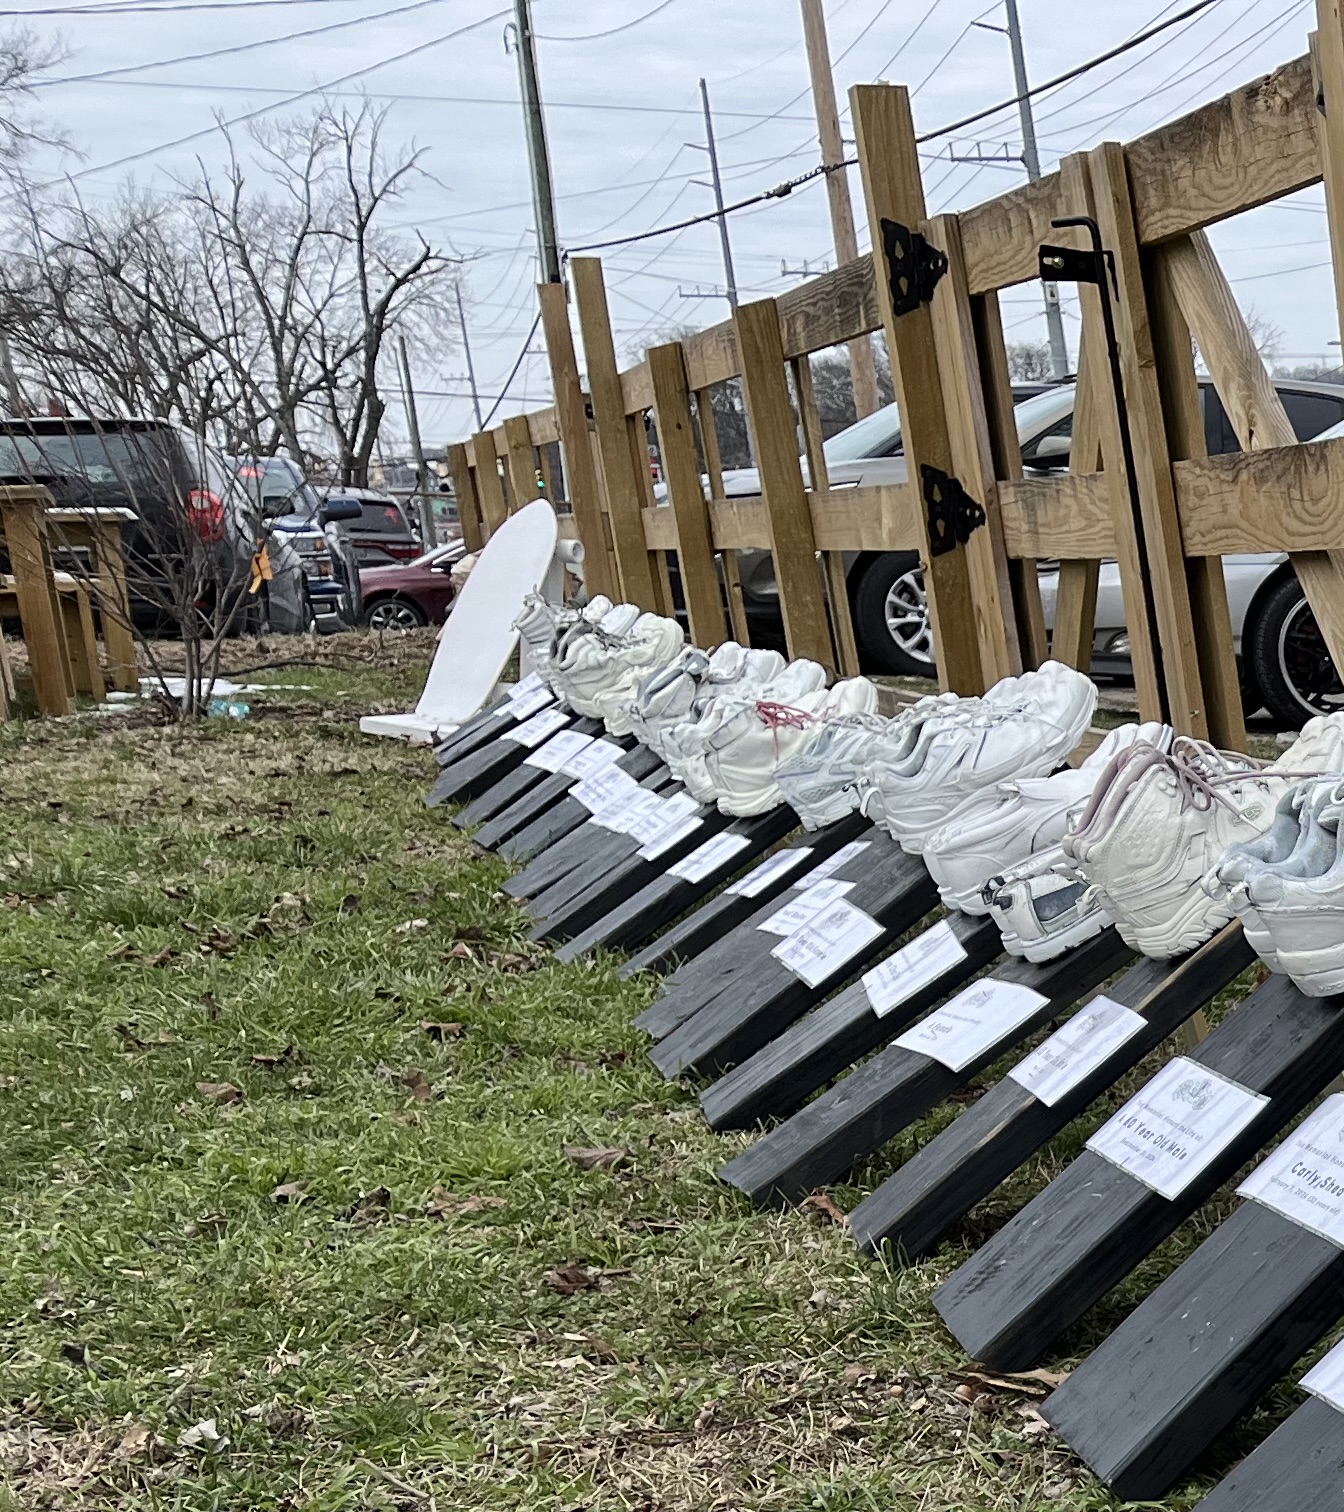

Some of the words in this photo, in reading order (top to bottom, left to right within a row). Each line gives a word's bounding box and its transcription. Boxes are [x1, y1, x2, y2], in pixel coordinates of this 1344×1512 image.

[1134, 1121, 1155, 1140] Year
[1153, 1134, 1171, 1149] Old
[1165, 1141, 1187, 1160] Male
[1291, 1161, 1321, 1187] Carly
